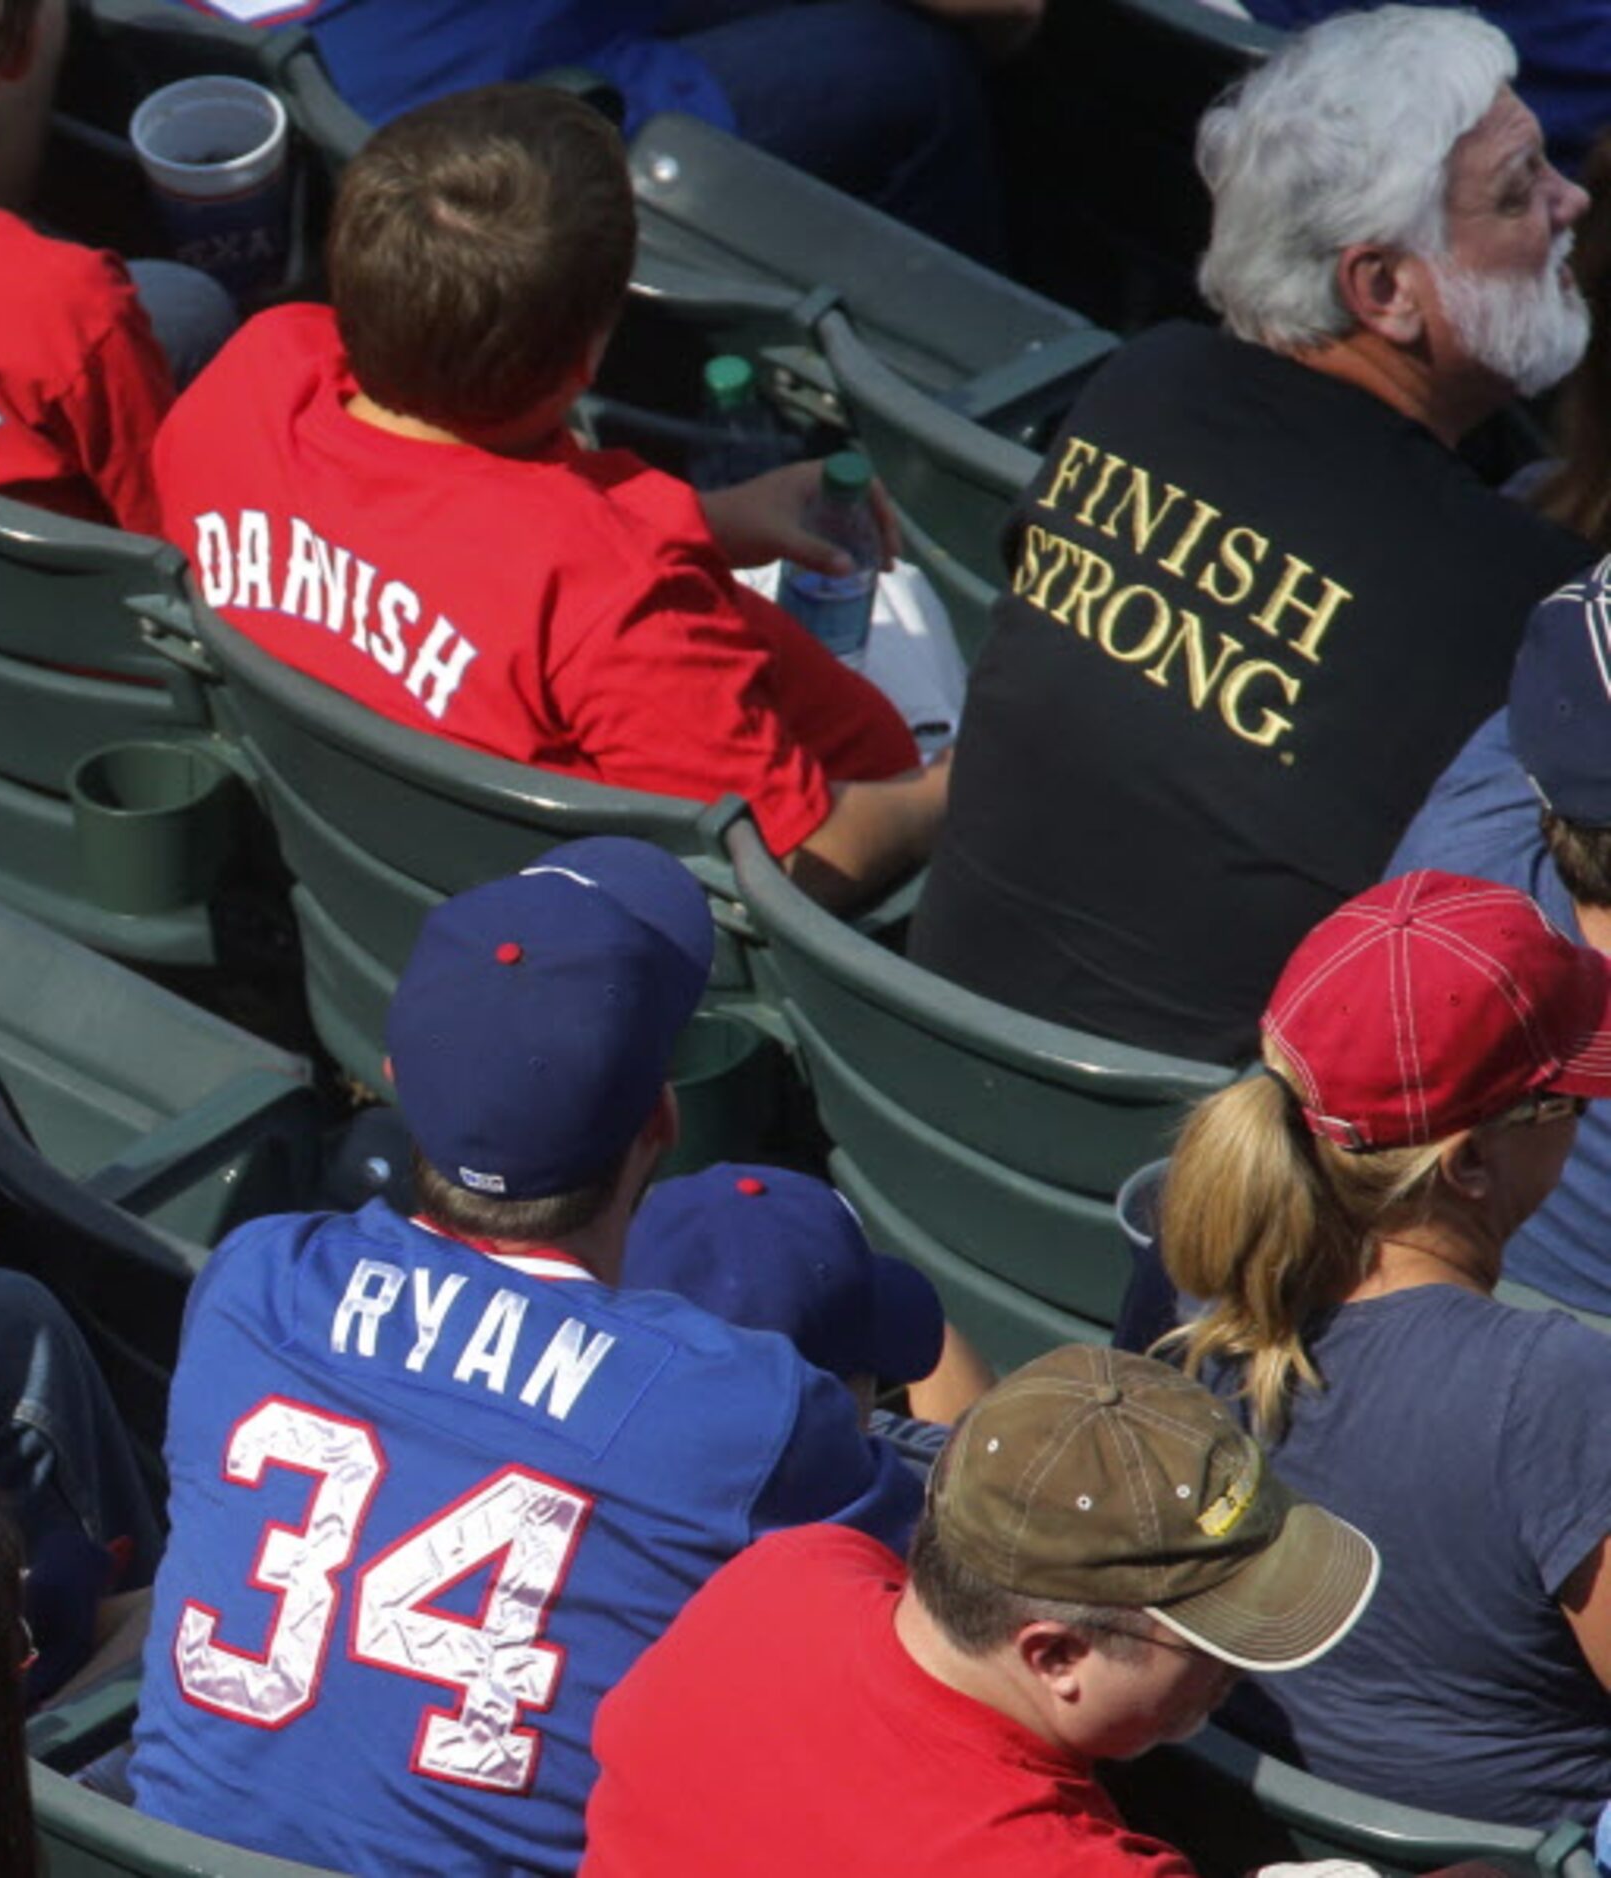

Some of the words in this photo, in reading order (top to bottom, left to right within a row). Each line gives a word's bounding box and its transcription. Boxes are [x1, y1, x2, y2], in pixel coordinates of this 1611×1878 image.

[193, 508, 478, 720] DARVISH
[1037, 436, 1353, 663] FINISH
[330, 1258, 616, 1421] RYAN
[172, 1393, 594, 1796] 34
